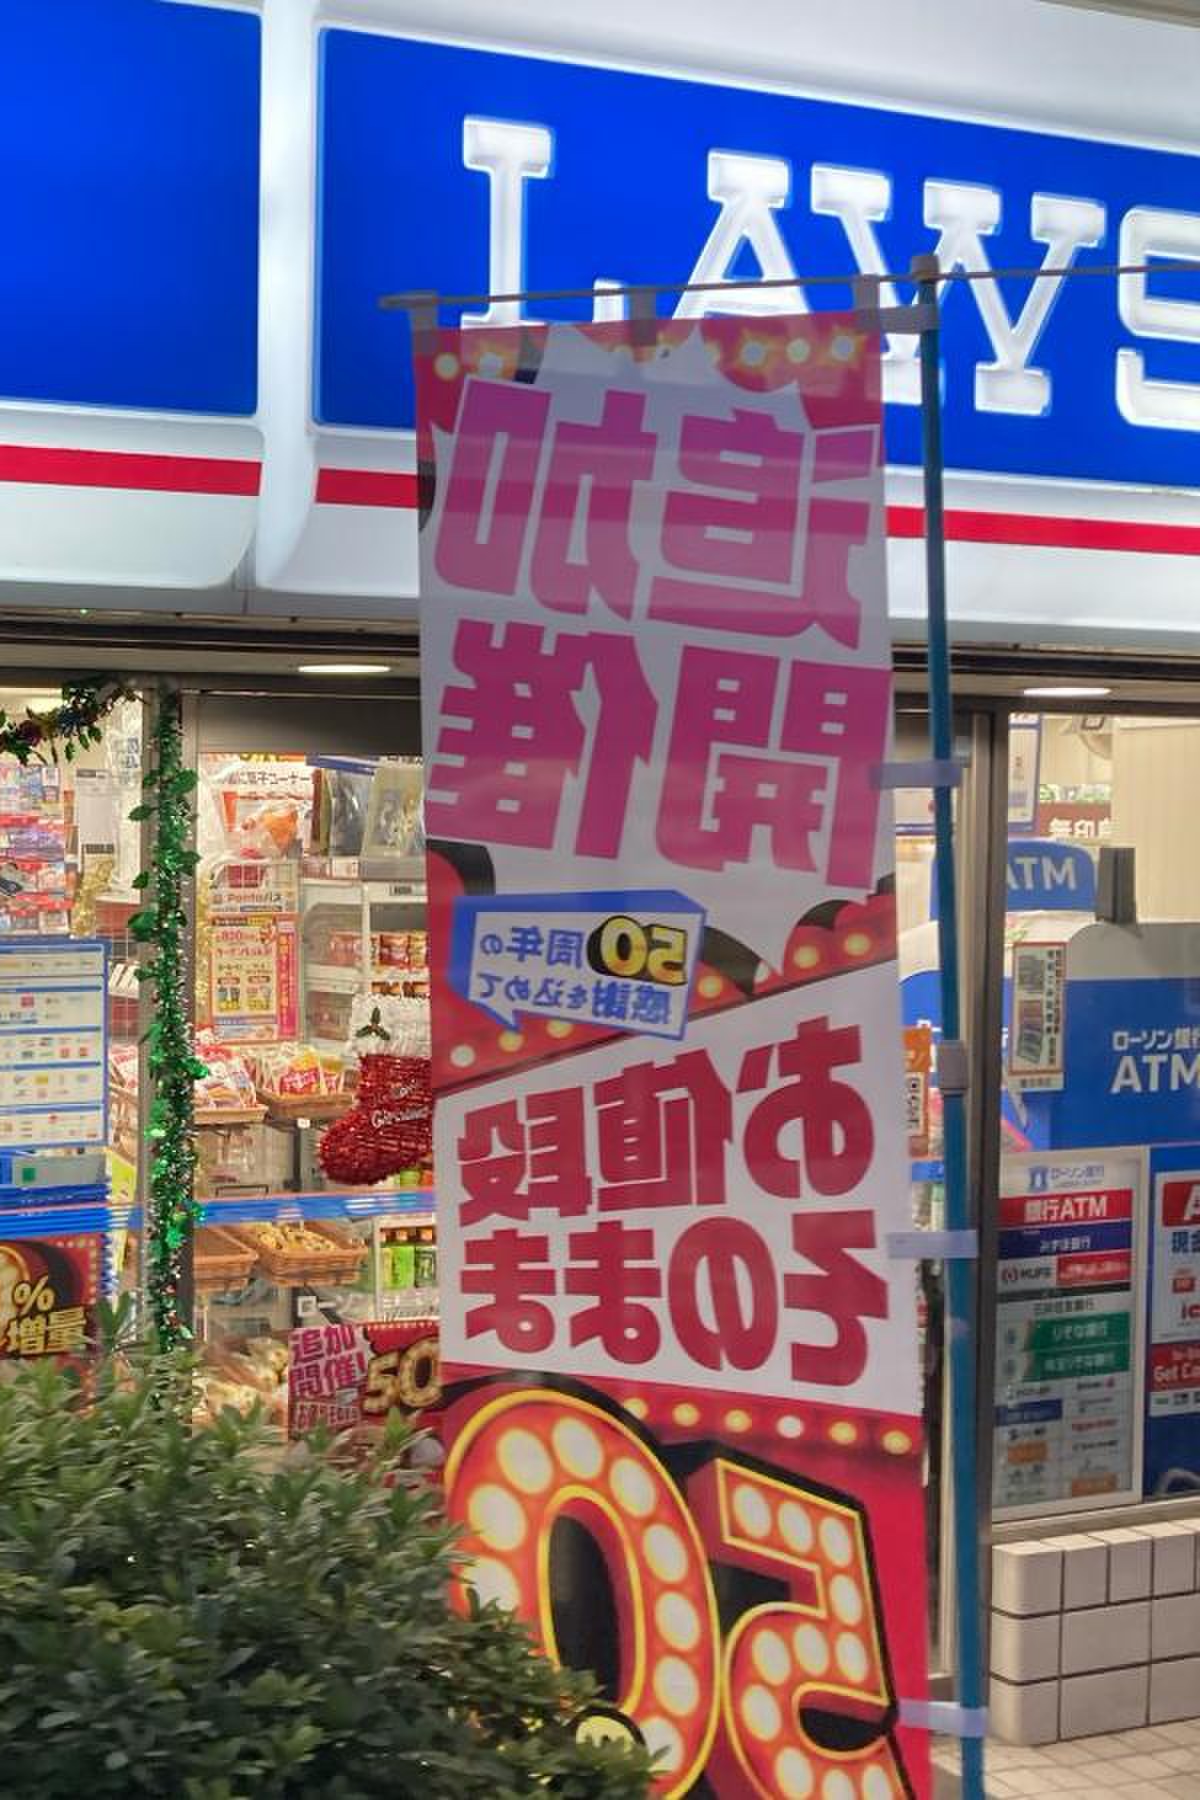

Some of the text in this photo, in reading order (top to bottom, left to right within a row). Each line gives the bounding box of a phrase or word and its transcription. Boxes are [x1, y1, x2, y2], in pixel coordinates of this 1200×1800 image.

[1007, 856, 1077, 892] TM
[1110, 1053, 1200, 1094] ATM
[6, 1305, 86, 1355] 増量
[291, 1323, 356, 1366] 追加
[362, 1337, 441, 1410] 50
